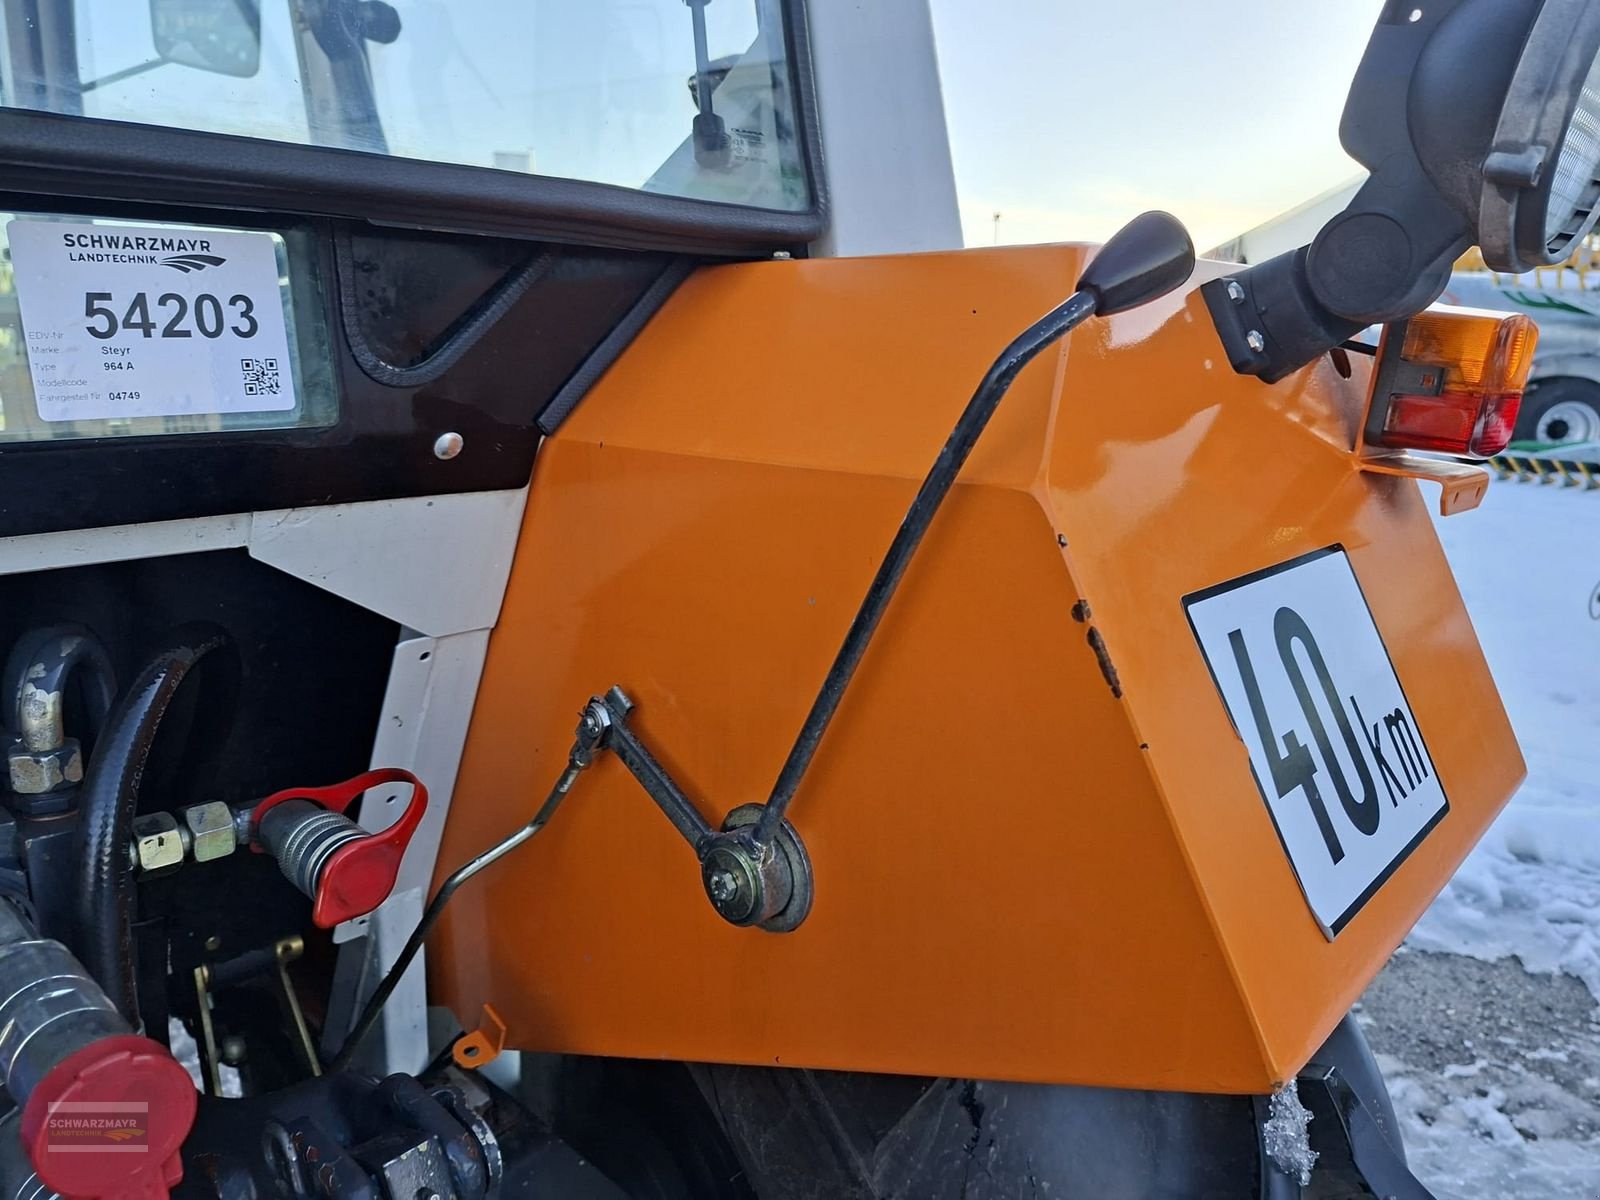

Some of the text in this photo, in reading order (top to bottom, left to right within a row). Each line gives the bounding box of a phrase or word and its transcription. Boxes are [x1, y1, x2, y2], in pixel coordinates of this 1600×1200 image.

[63, 233, 212, 252] SCHWARZMAYR
[69, 252, 158, 264] LANDTECHNIK
[85, 291, 259, 340] 54203
[101, 345, 131, 357] Steyr
[34, 361, 135, 372] Type 964 A
[38, 378, 88, 388] Modellcode
[40, 392, 88, 402] Fahrgestell
[108, 391, 141, 401] 04749
[1227, 606, 1429, 866] 40 km
